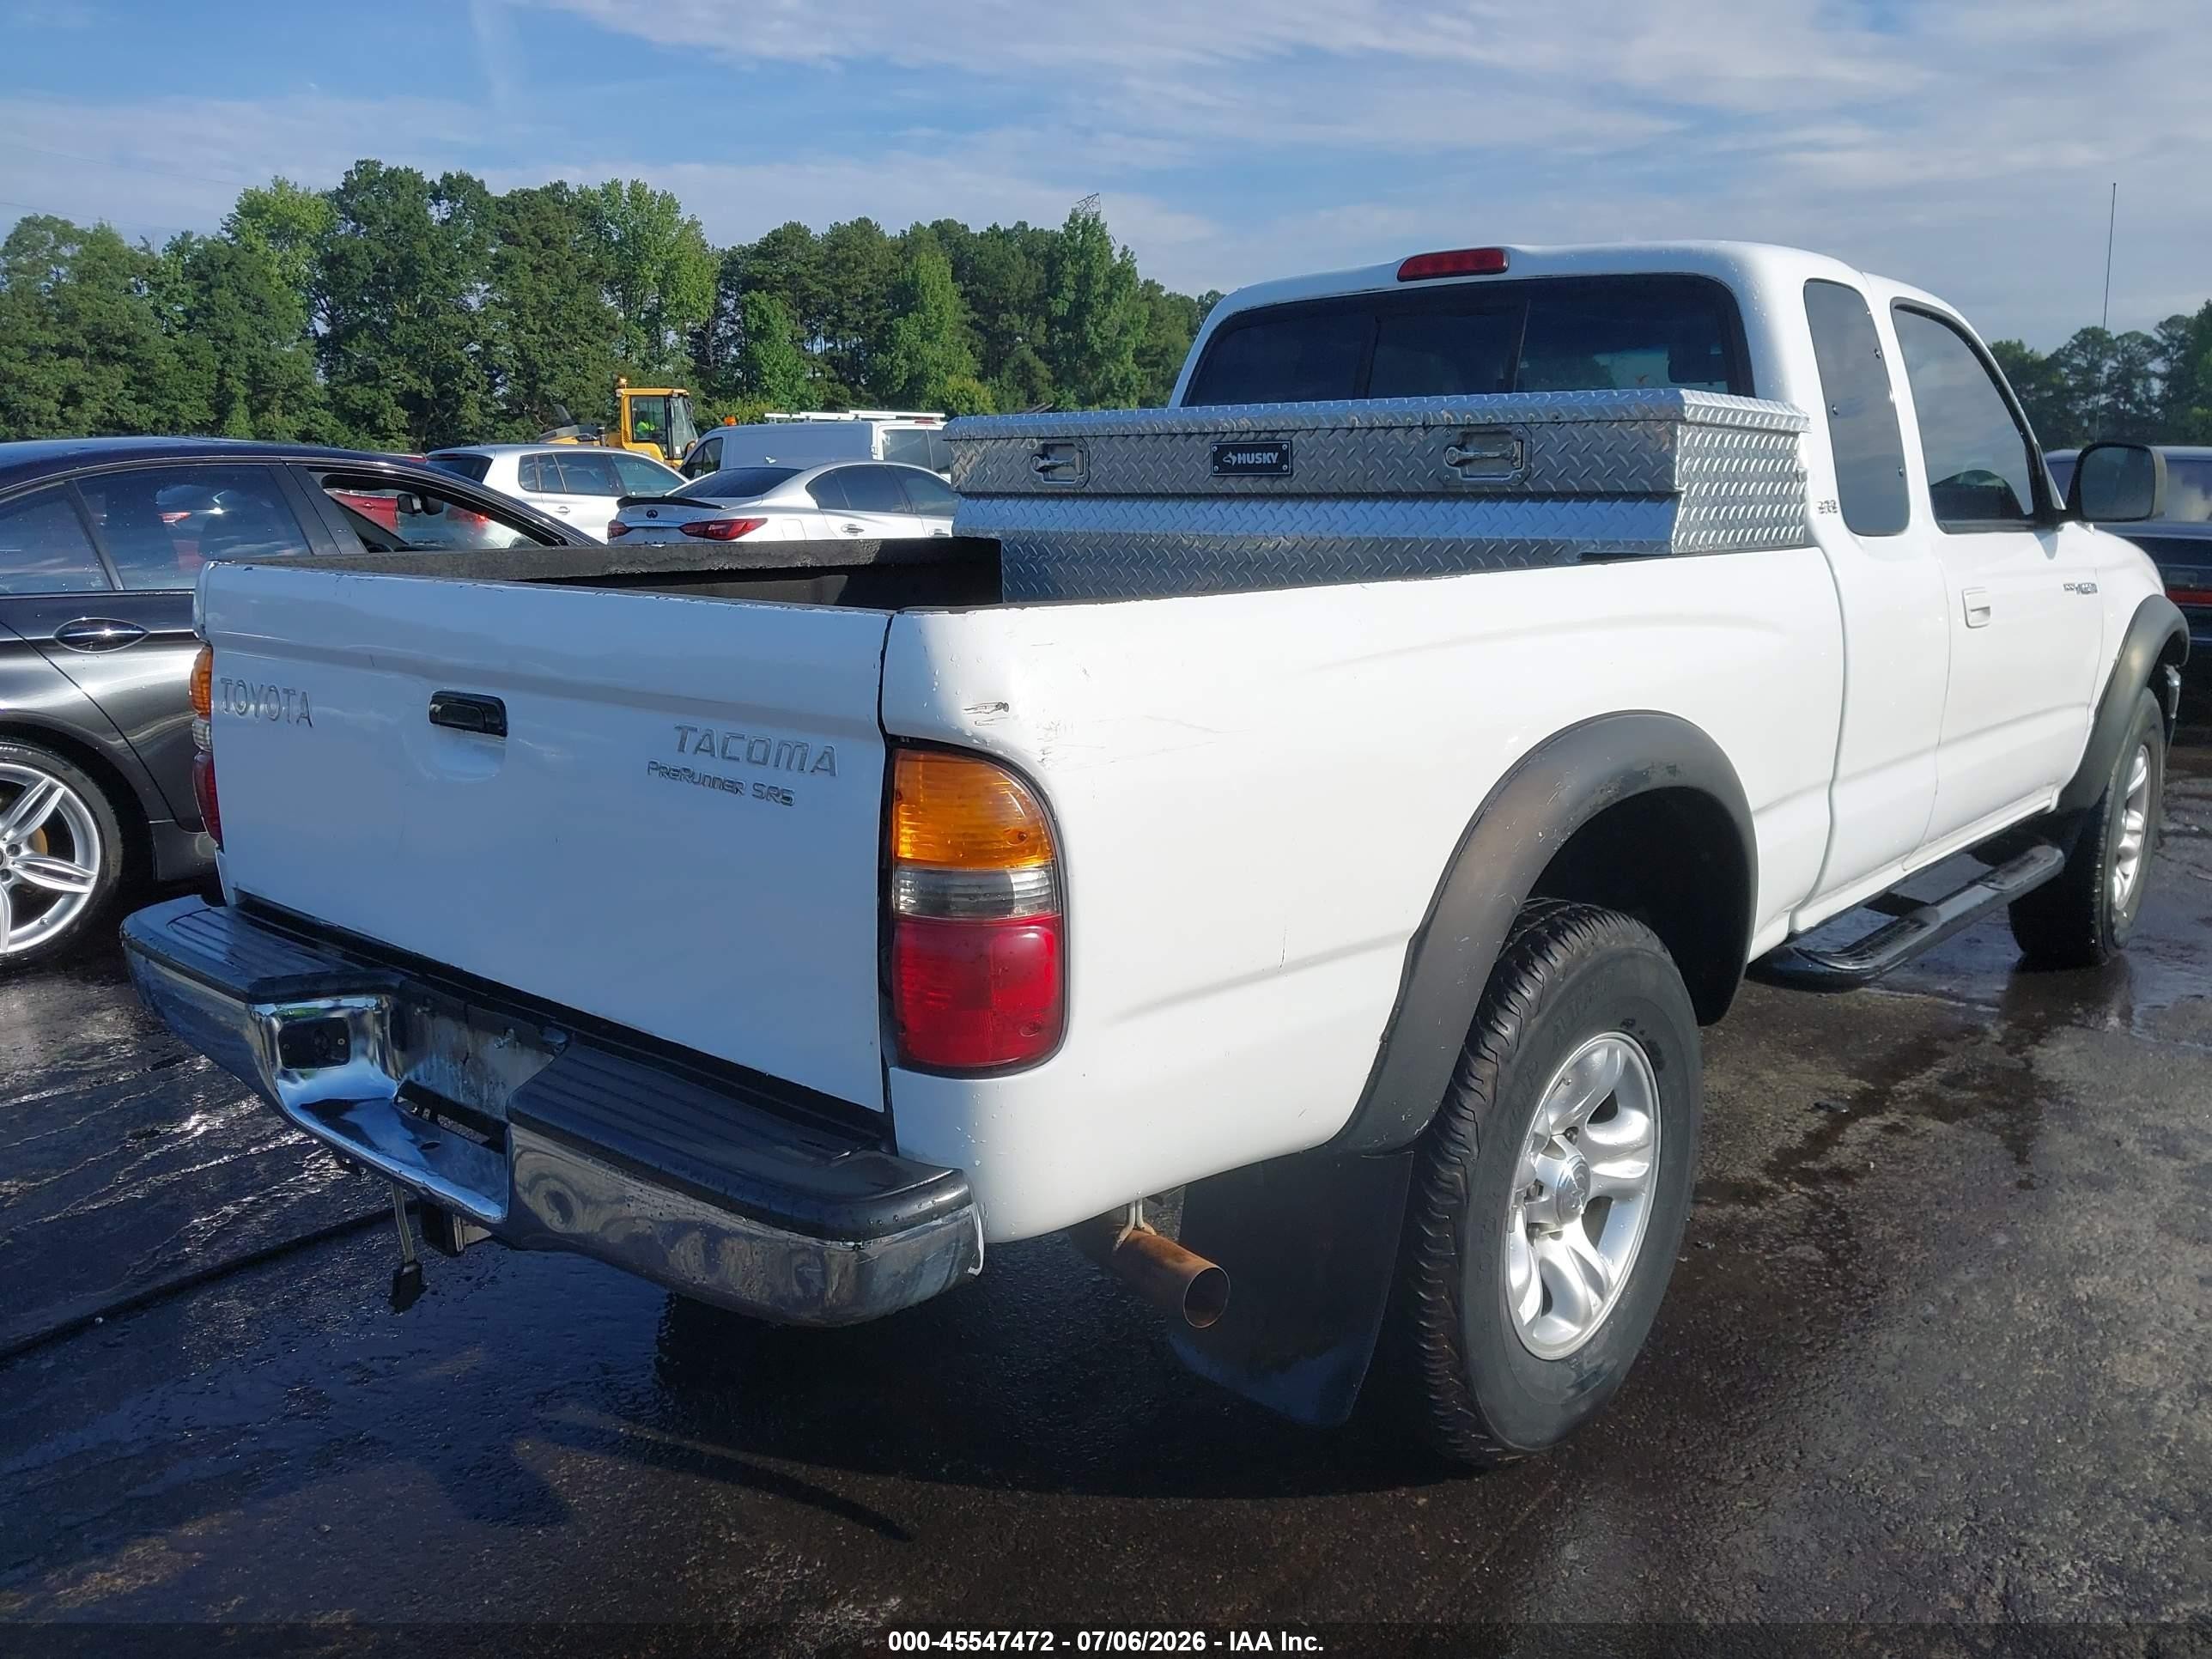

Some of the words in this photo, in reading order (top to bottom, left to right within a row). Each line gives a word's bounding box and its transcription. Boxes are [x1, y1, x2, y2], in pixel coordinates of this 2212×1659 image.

[1237, 452, 1279, 465] HUSKY
[220, 677, 313, 728] TOYOTA
[674, 723, 839, 777] TACOMA
[751, 781, 796, 807] SR5
